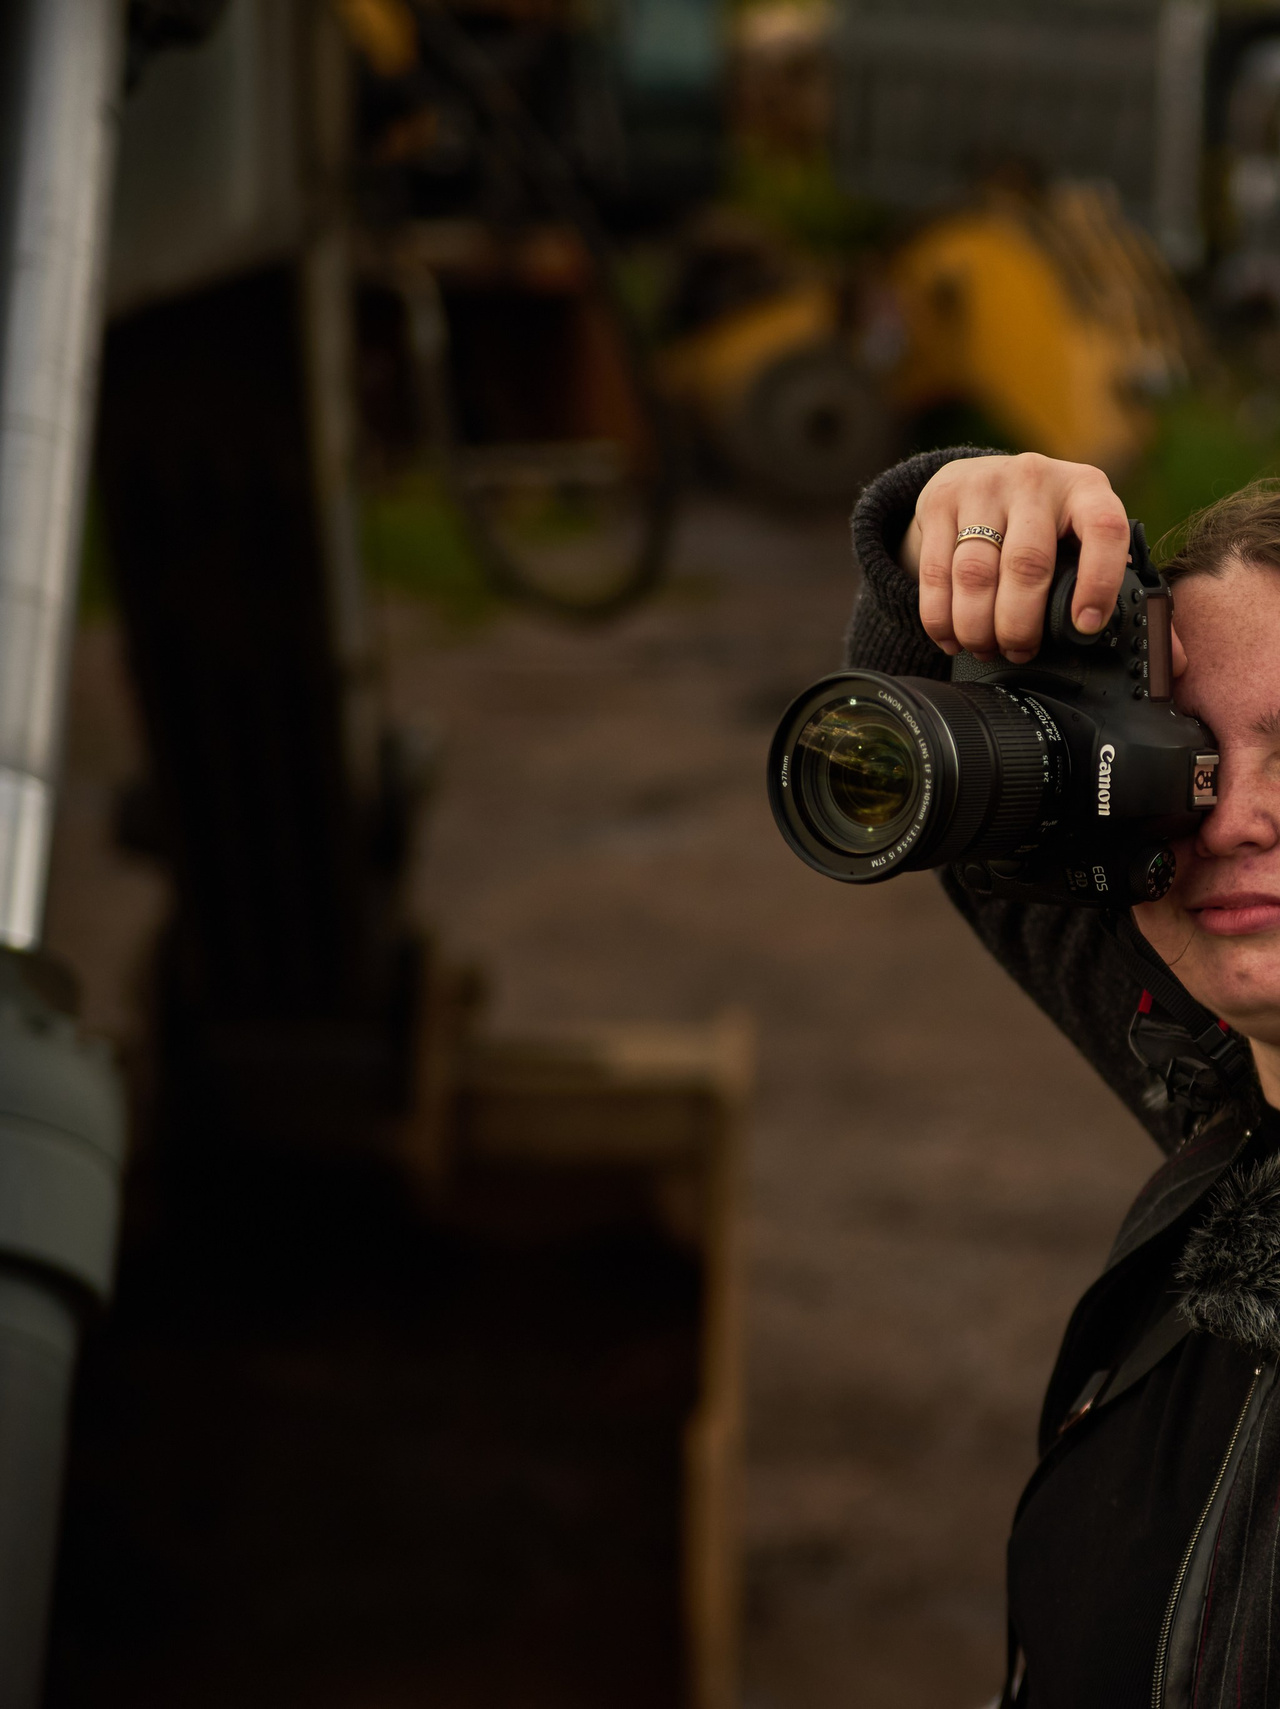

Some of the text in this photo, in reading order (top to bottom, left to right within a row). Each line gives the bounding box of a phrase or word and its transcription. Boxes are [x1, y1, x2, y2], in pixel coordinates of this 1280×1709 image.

[878, 690, 902, 711] CANON
[1020, 706, 1030, 715] 70
[903, 711, 921, 736] ZOOM
[1024, 697, 1056, 741] 24-105mm
[1036, 730, 1044, 741] 50
[918, 738, 929, 760] LENS
[924, 764, 932, 774] EF
[1042, 754, 1049, 766] 35
[1043, 771, 1050, 783] 24
[1098, 744, 1115, 816] Canon
[918, 779, 931, 820] 24-105mm
[897, 824, 920, 853] 1:3.5-5.6
[871, 857, 887, 868] STM
[1075, 870, 1089, 889] 6D
[1092, 865, 1108, 892] EOS
